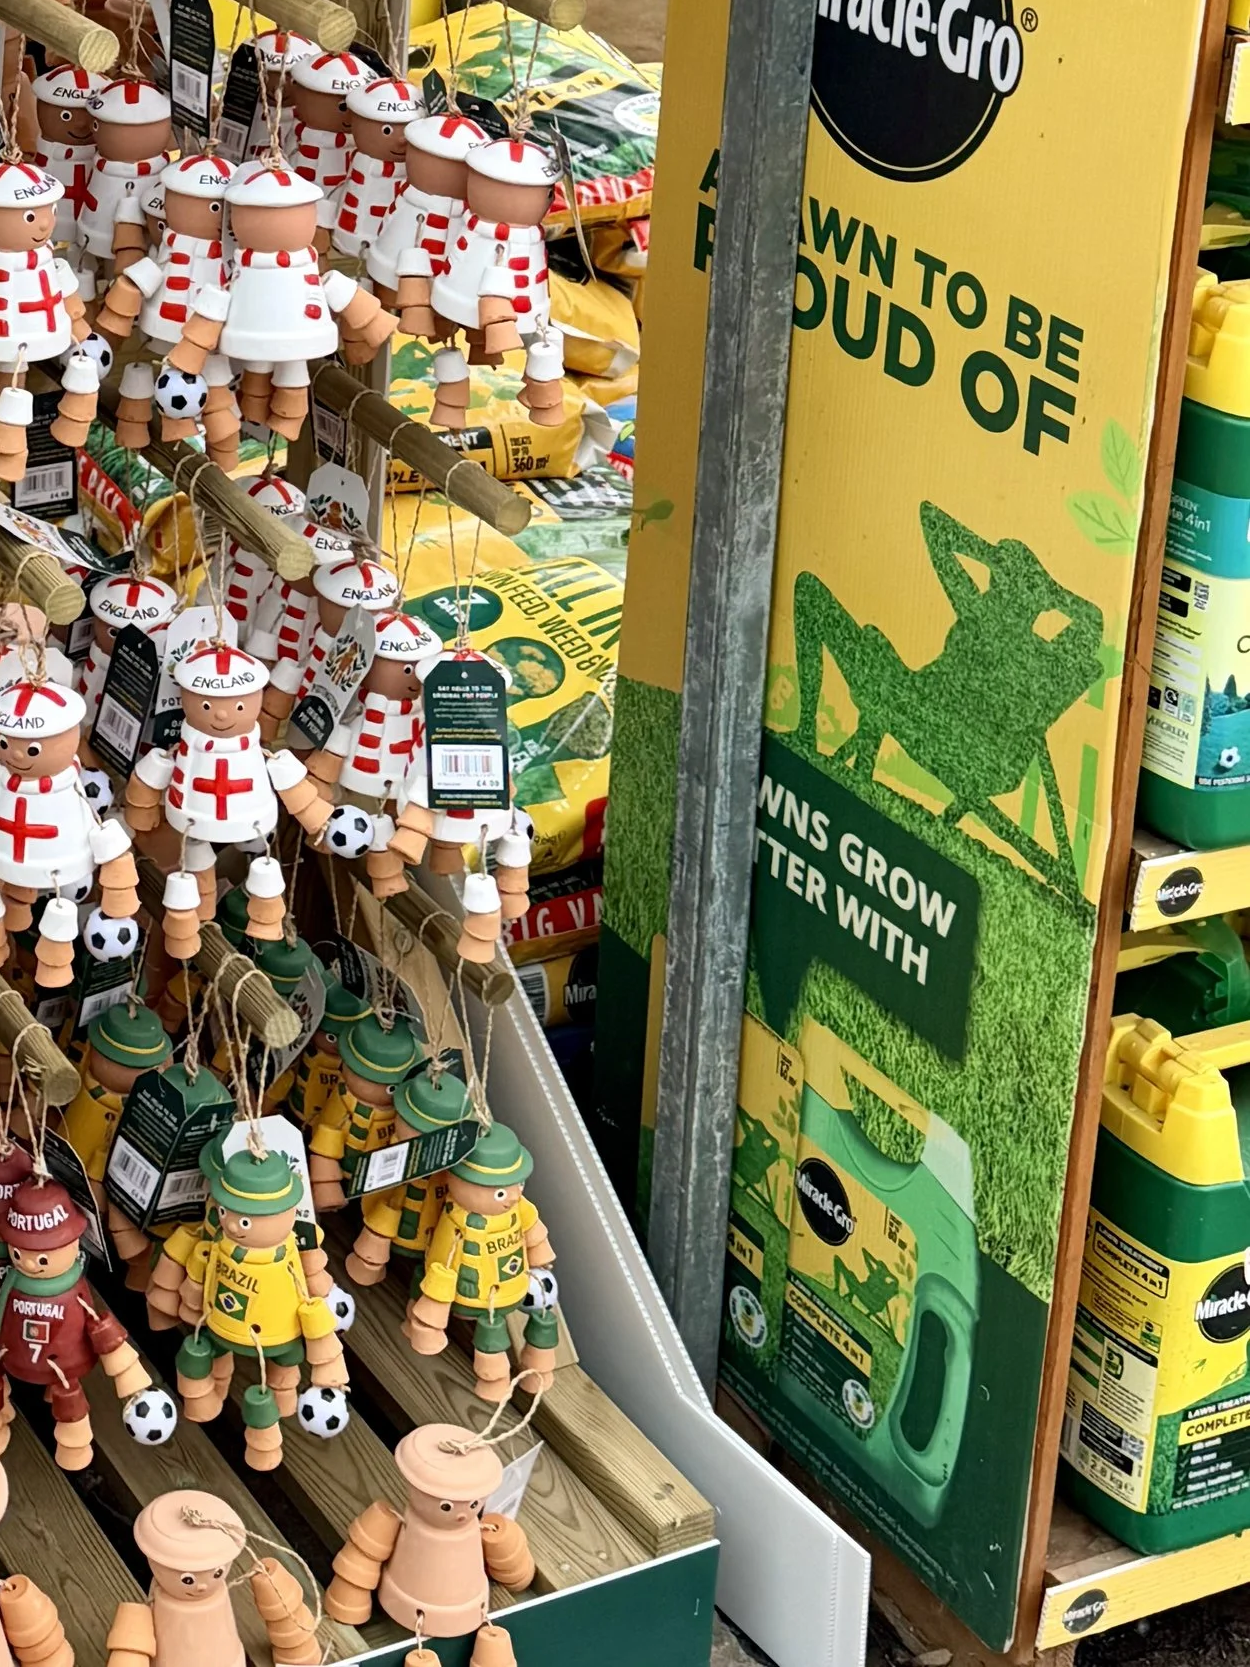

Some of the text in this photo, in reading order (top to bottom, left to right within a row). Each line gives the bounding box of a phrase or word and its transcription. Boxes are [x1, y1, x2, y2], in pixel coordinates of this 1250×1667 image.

[796, 198, 1083, 383] WN TO BE
[693, 200, 1076, 456] POUD OF
[512, 455, 533, 472] 360
[87, 474, 121, 514] PACK
[1186, 512, 1211, 532] 4in1
[98, 598, 160, 620] ENGLAND
[380, 633, 432, 652] ENGLAND
[538, 614, 592, 665] WEED
[192, 672, 255, 689] ENGLAND
[839, 832, 956, 938] GROW
[502, 908, 554, 946] BIG
[836, 884, 928, 986] WITH
[565, 984, 597, 1005] Mira
[213, 1261, 259, 1295] BRAZIL
[12, 1297, 65, 1322] PORTUGAL
[29, 1343, 44, 1364] 7
